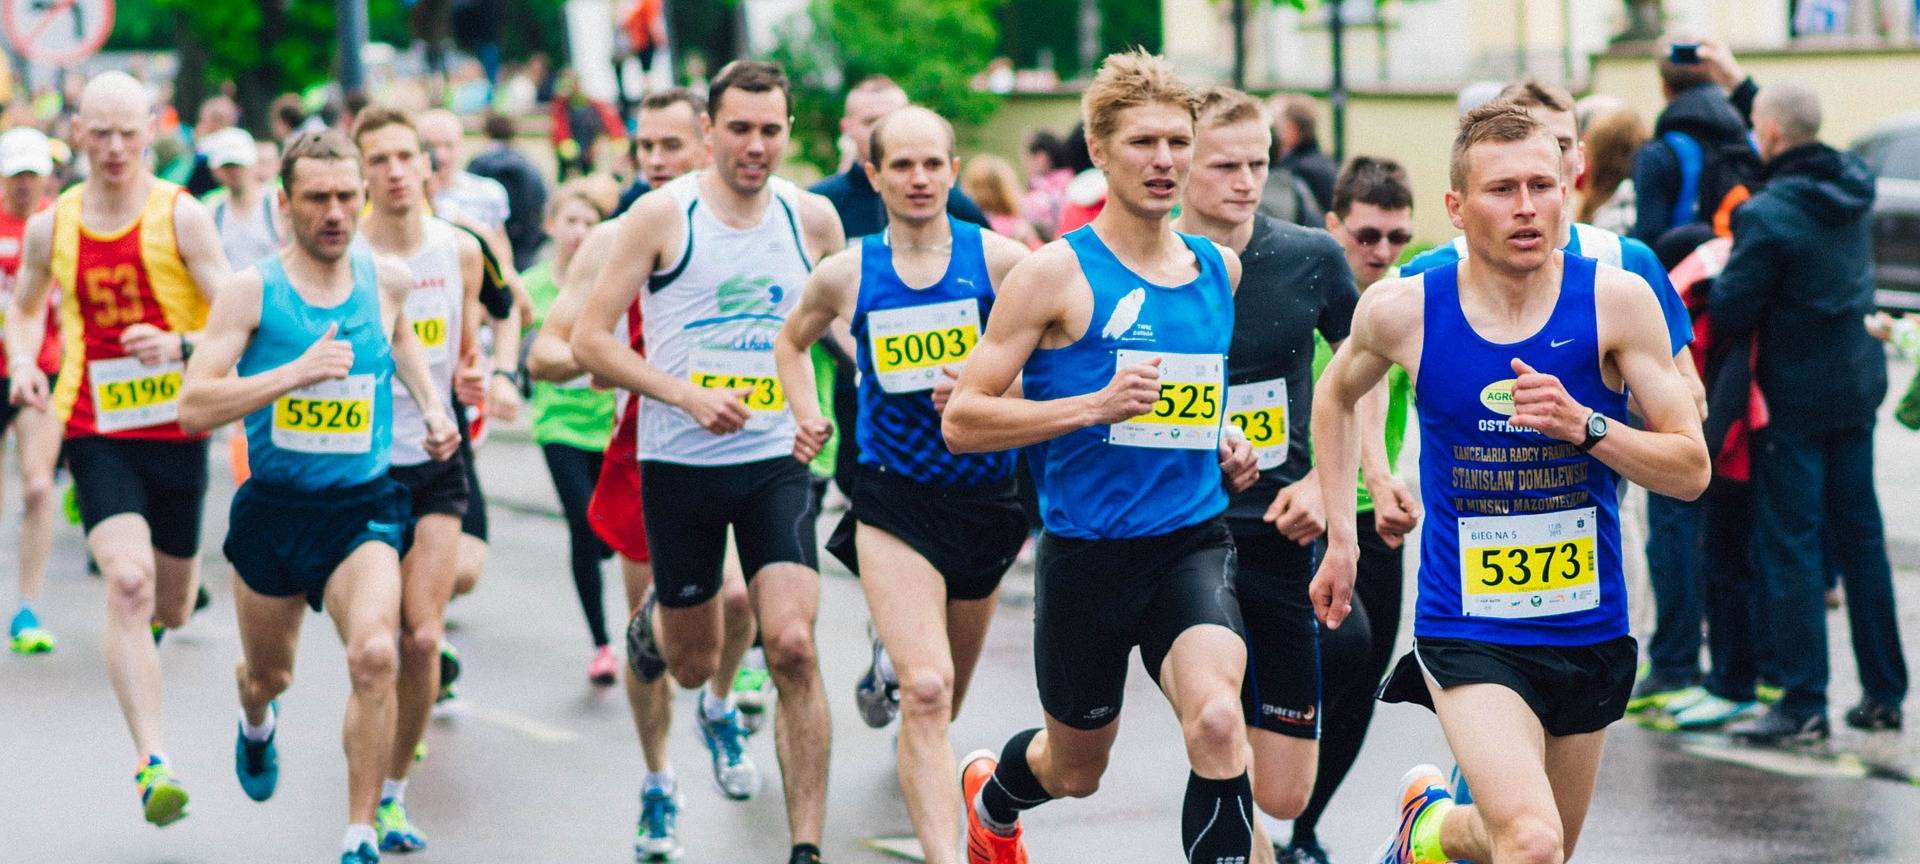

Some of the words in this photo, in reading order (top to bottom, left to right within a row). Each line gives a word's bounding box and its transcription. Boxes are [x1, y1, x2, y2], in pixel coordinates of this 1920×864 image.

[87, 263, 145, 328] 53
[885, 328, 966, 366] 5003
[107, 373, 175, 407] 5196
[287, 398, 362, 428] 5526
[1453, 445, 1507, 463] KANCELARIA
[1510, 446, 1539, 462] RADCY
[1471, 531, 1493, 540] BIEG
[1495, 531, 1509, 539] NA
[1511, 530, 1517, 539] 5
[1481, 542, 1581, 586] 5373
